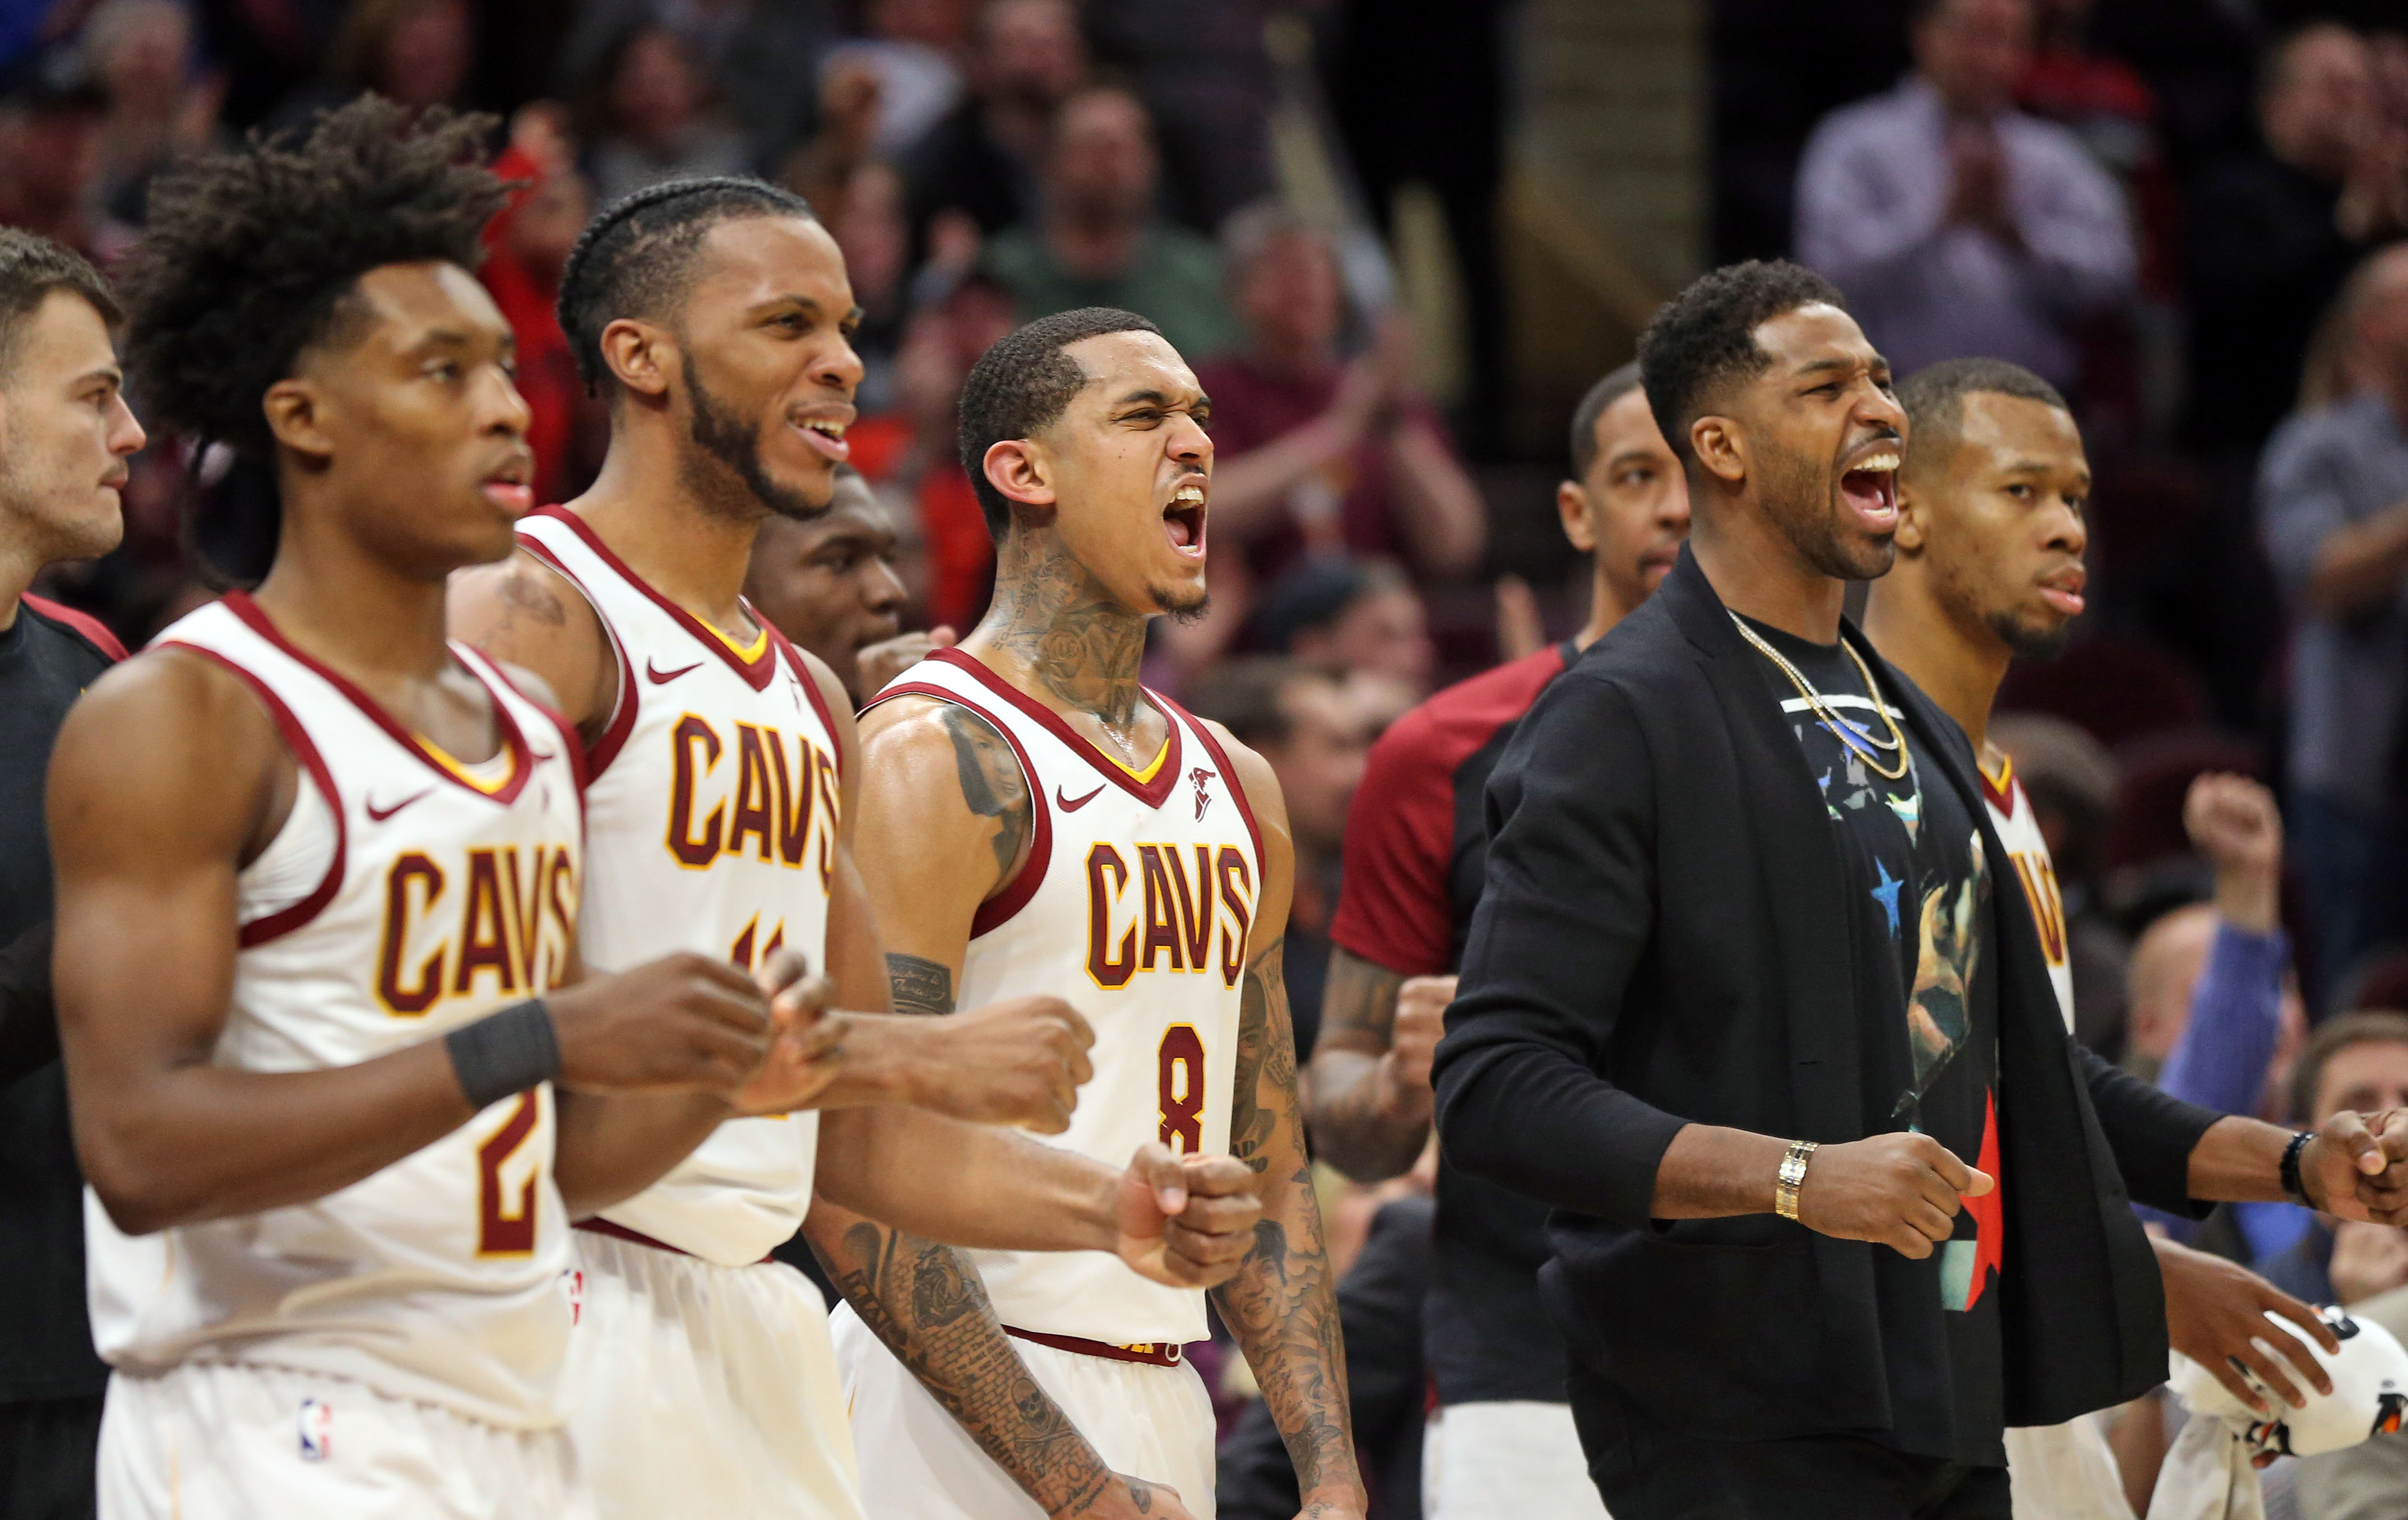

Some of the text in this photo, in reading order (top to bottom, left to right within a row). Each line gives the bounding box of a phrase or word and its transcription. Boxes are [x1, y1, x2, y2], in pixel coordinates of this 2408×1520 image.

[664, 711, 840, 898] CAVS
[372, 845, 575, 1017] CAVS
[1085, 841, 1252, 990] CAVS
[1157, 1022, 1206, 1159] 8
